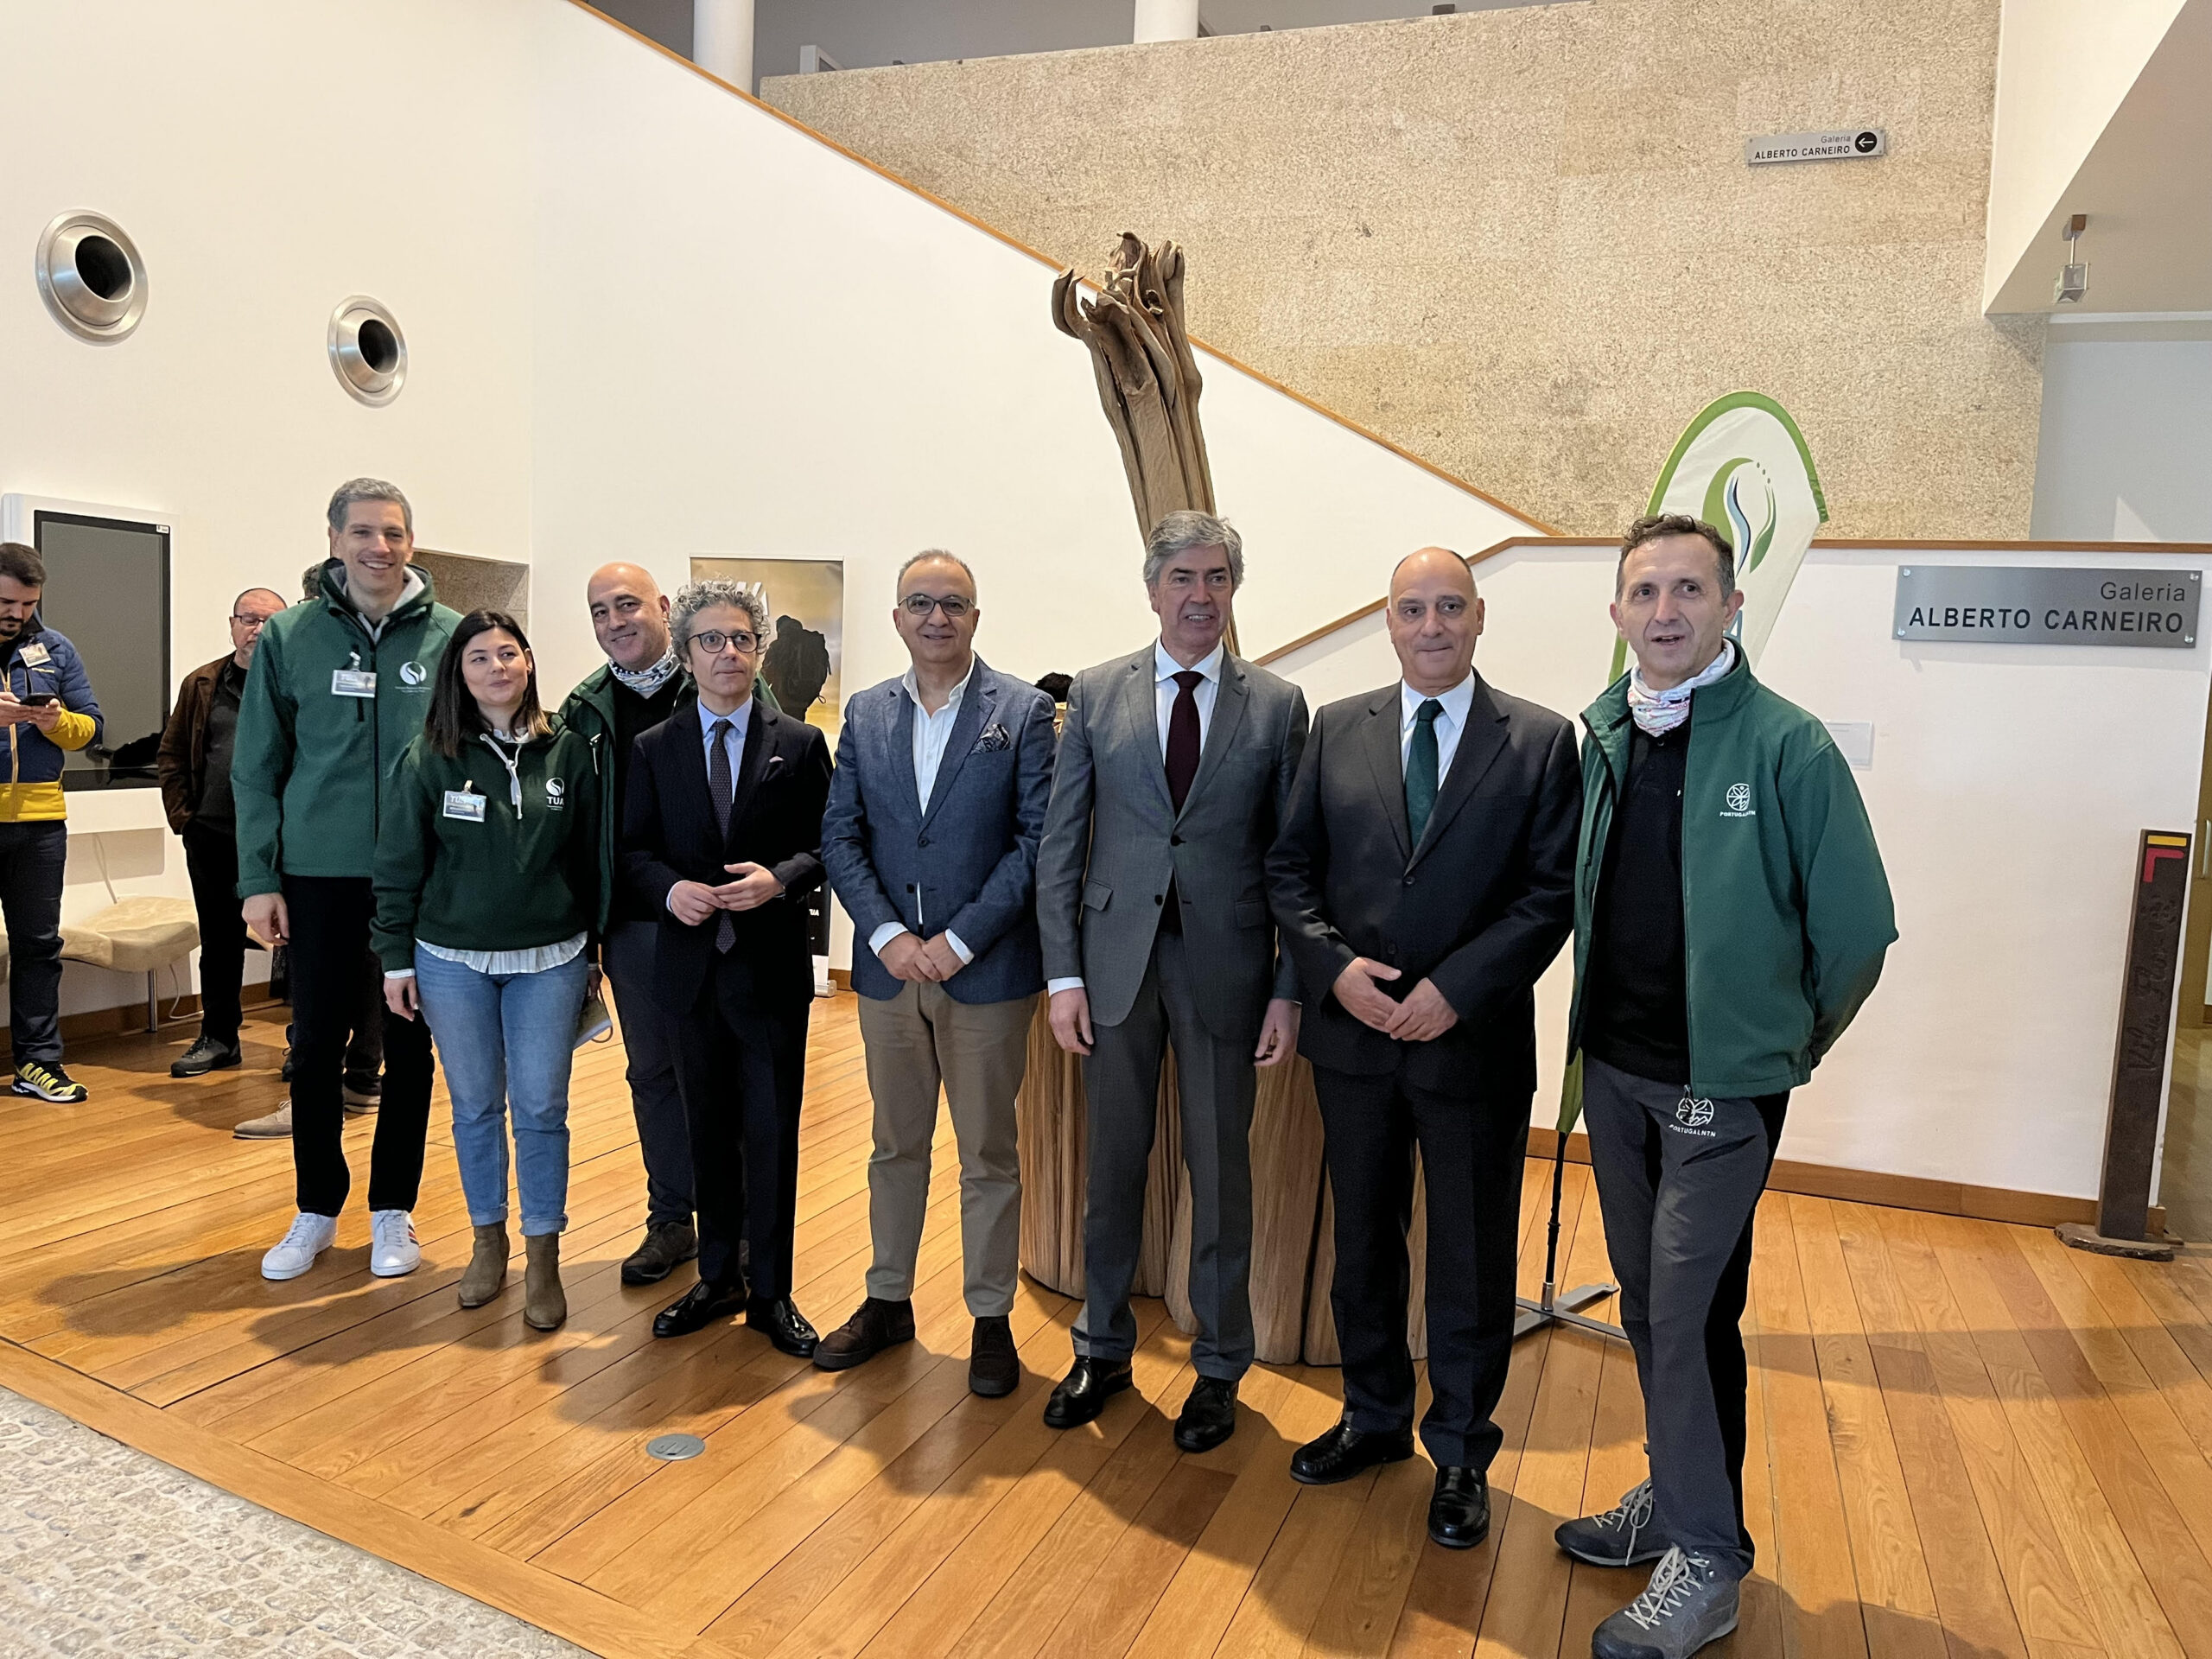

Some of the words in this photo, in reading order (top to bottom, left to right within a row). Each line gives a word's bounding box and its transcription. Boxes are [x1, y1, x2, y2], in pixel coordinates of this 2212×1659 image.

[1821, 135, 1852, 143] Galeria
[1755, 149, 1798, 160] ALBERTO
[1802, 145, 1851, 156] CARNEIRO
[2101, 582, 2185, 602] Galeria
[1909, 607, 2031, 629] ALBERTO
[2044, 609, 2183, 633] CARNEIRO
[546, 797, 564, 805] TUA
